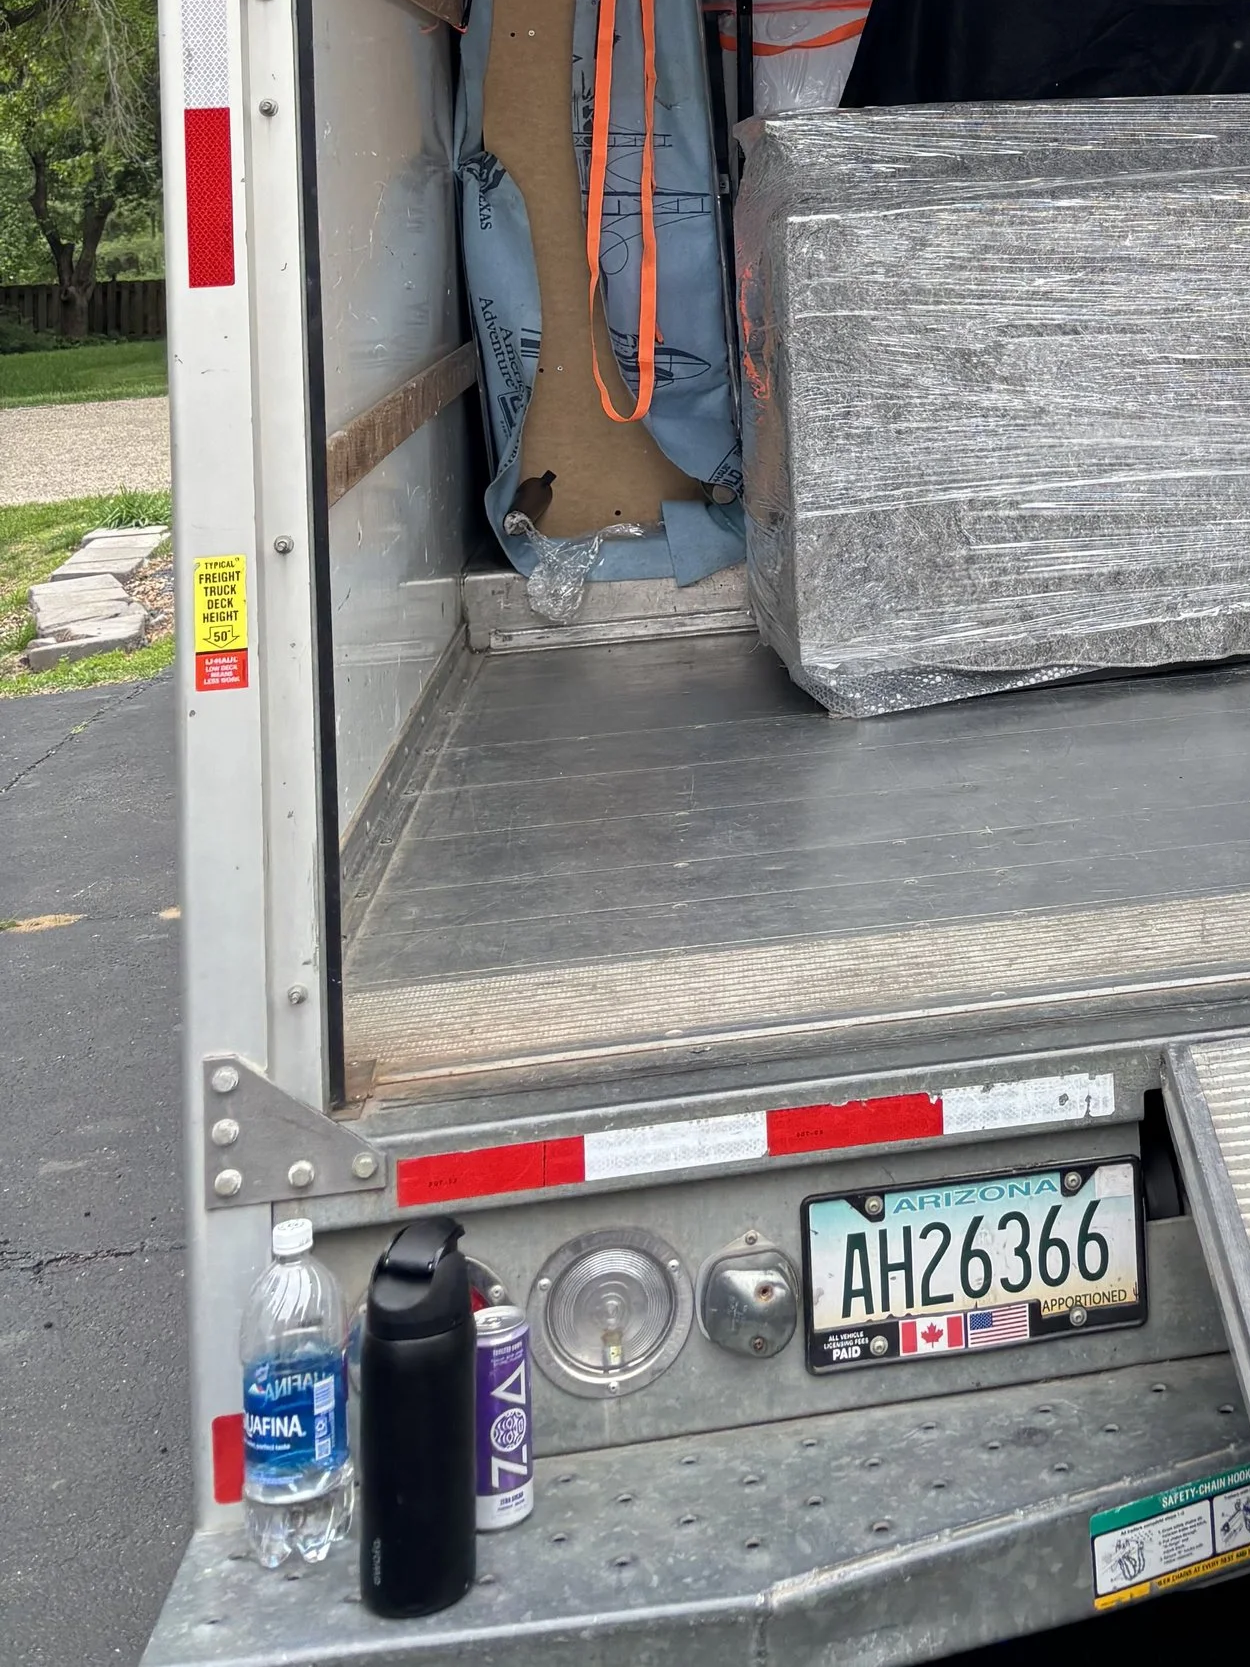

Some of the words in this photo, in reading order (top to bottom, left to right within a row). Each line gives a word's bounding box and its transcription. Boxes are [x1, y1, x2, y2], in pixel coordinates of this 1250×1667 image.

[204, 560, 236, 570] TYPICAL
[199, 570, 241, 584] FREIGHT
[203, 584, 237, 597] TRUCK
[207, 597, 234, 610] DECK
[202, 610, 240, 624] HEIGHT
[205, 665, 220, 673] LOW
[892, 1178, 1059, 1214] ARIZONA
[841, 1199, 1109, 1319] AH26366
[1042, 1289, 1128, 1314] APPORTIONED
[828, 1334, 839, 1342] ALL
[840, 1330, 864, 1341] VEHICLE
[854, 1337, 869, 1345] FEES
[832, 1345, 861, 1361] PAID
[1161, 1477, 1226, 1509] SAFETY-CHAIN
